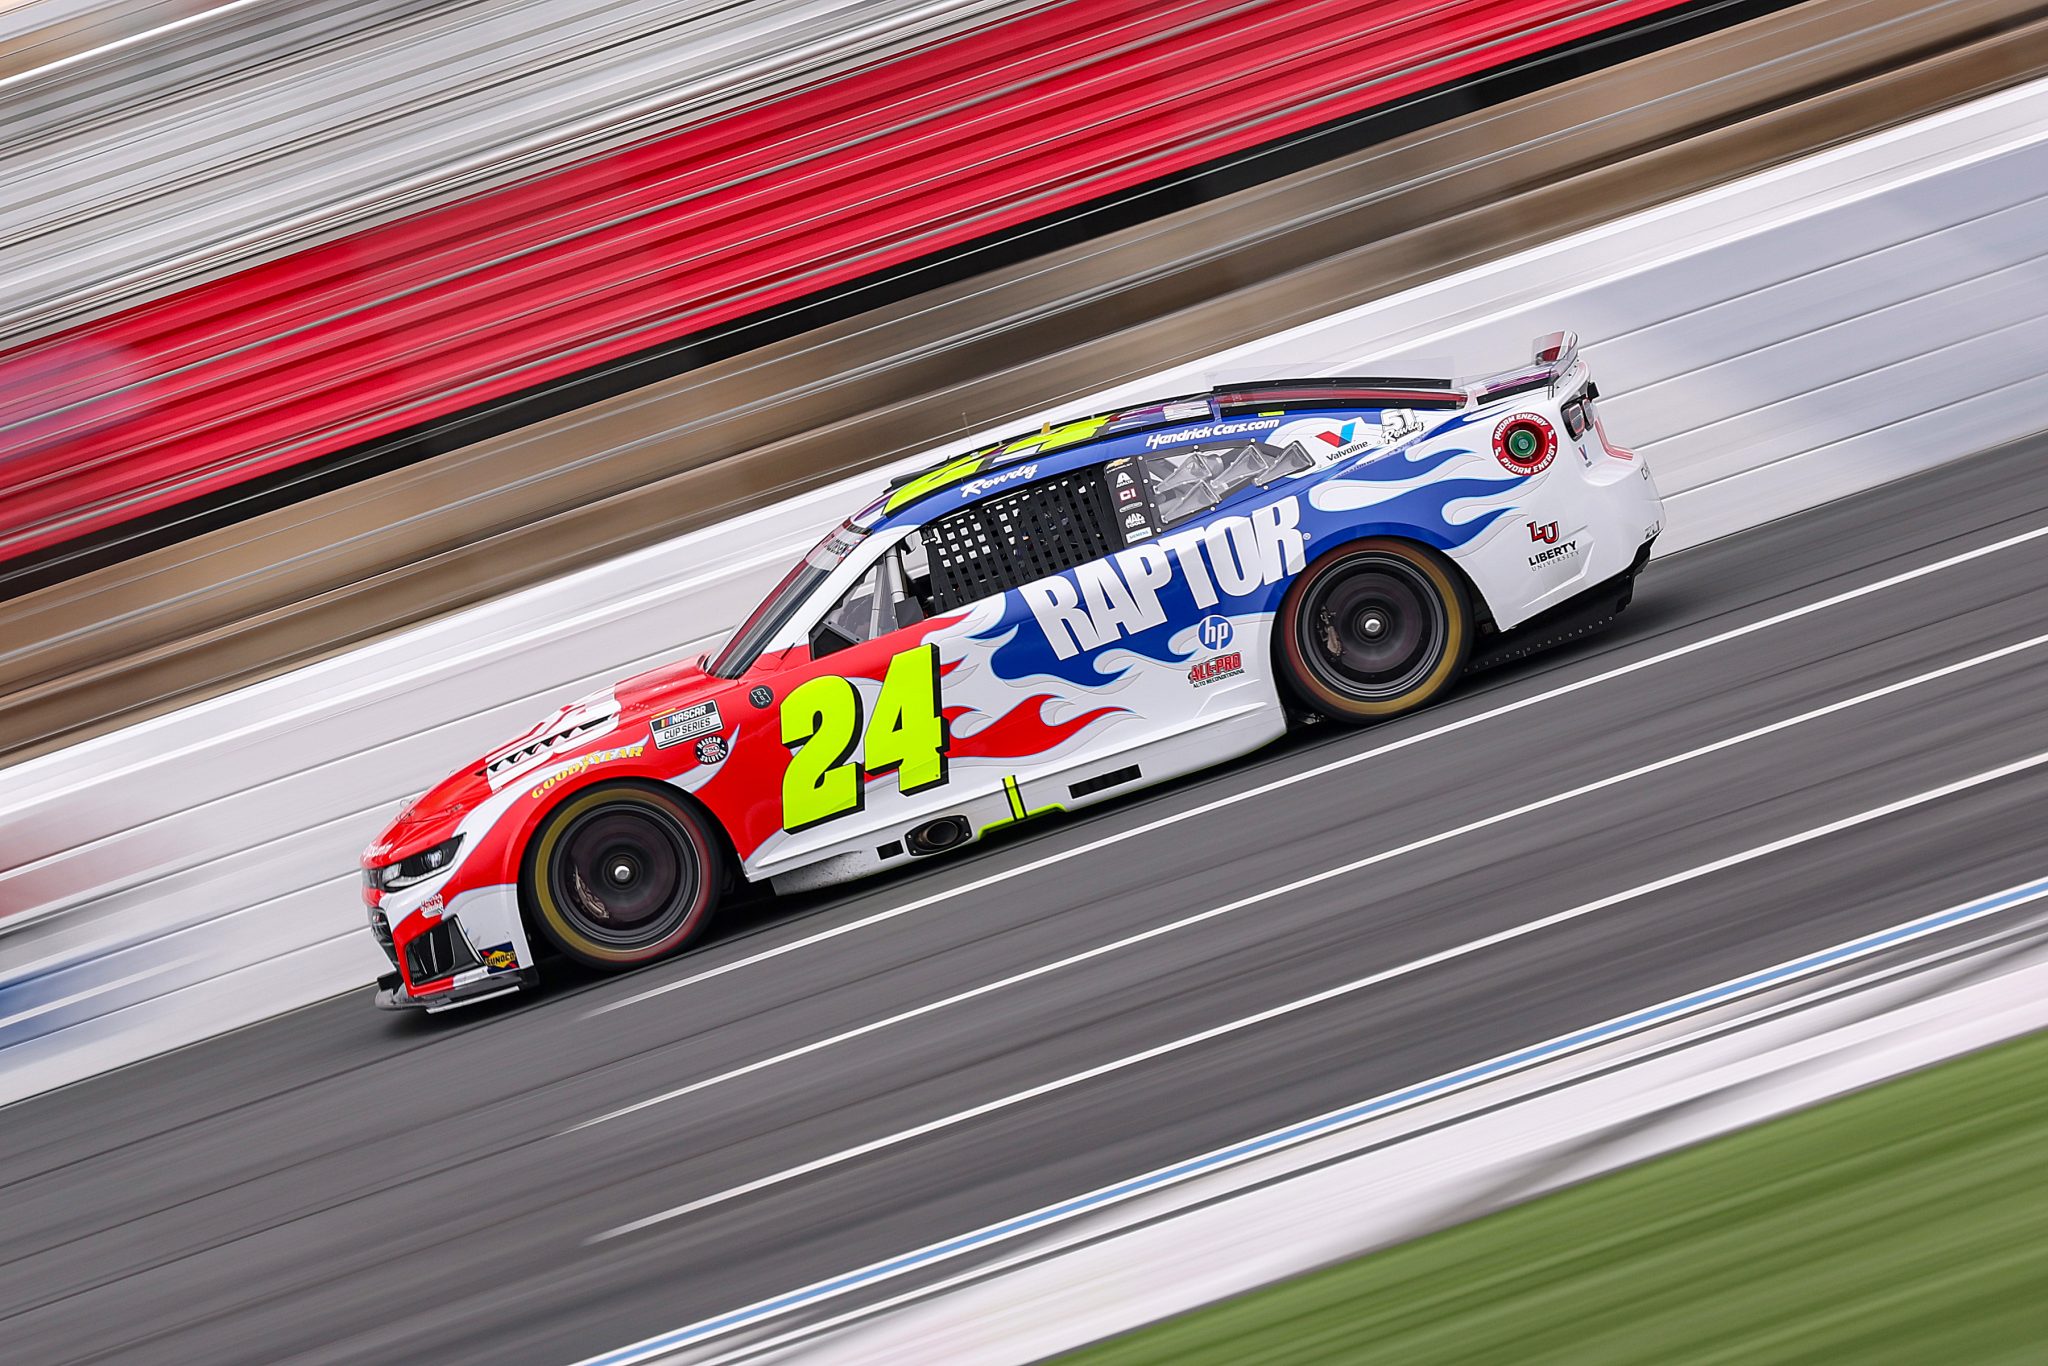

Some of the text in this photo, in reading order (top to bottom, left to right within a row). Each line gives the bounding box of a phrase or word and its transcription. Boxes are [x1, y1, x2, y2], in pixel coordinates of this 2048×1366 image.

[1381, 408, 1417, 431] 51
[1494, 413, 1548, 440] PHORM ENERGY
[1146, 419, 1279, 449] HendrickCars.com
[1382, 421, 1424, 444] Rowdy
[1326, 441, 1368, 461] Valvoline
[1500, 443, 1556, 474] PHORM ENERGY
[960, 464, 1038, 498] Rowdy
[1526, 520, 1560, 545] LU
[1528, 540, 1576, 566] LIBERTY
[1531, 551, 1579, 572] UNIVERSITY
[1018, 496, 1306, 661] RAPTOR
[1204, 616, 1229, 651] hp
[1190, 652, 1242, 682] ALL-PRO
[672, 705, 707, 724] NASCAR
[664, 717, 711, 740] CUP SERIES
[779, 642, 949, 835] 24
[696, 736, 721, 750] NASCAR
[700, 749, 726, 763] SALUTES
[531, 746, 644, 799] GOODYEAR
[485, 951, 516, 968] SUNOCO
